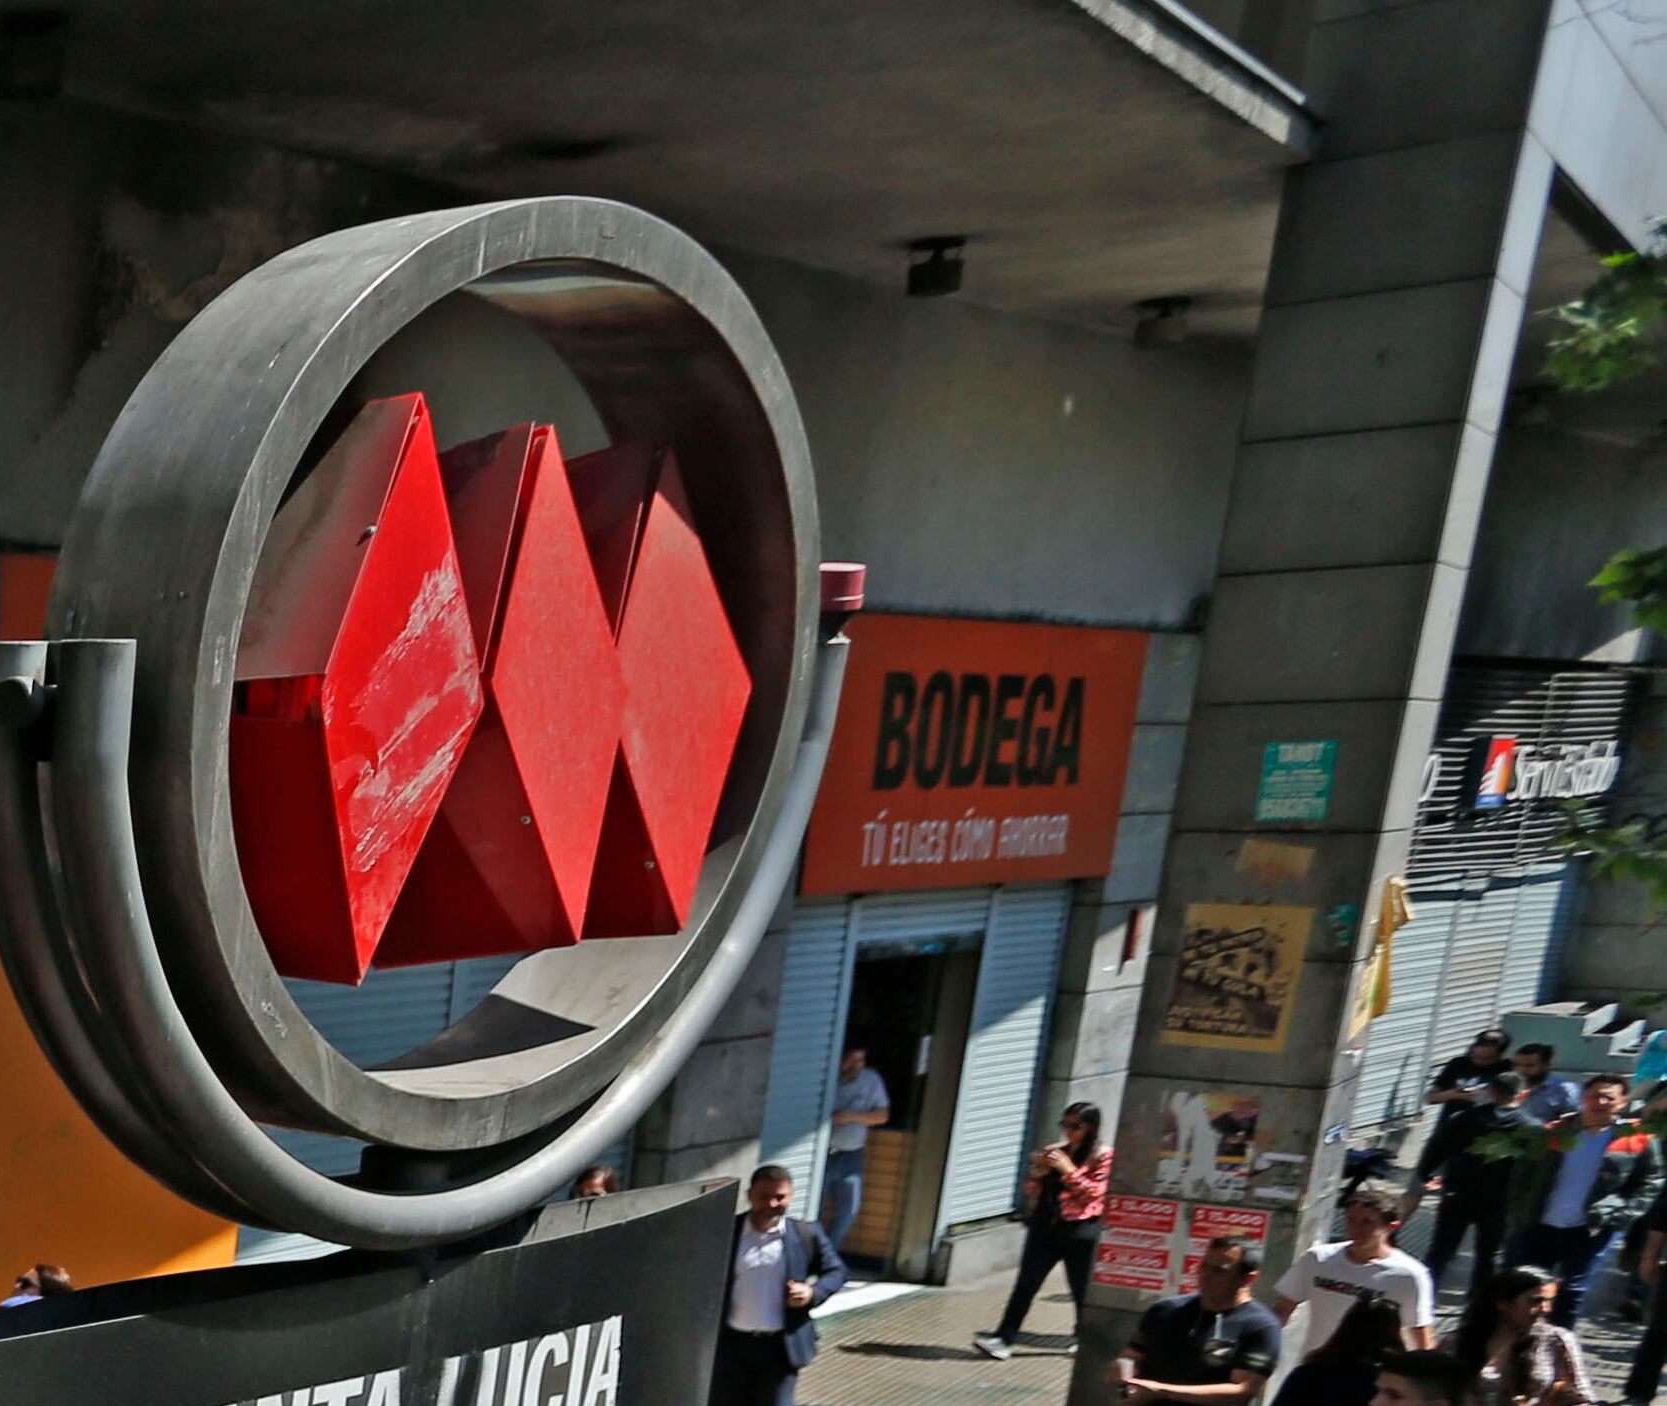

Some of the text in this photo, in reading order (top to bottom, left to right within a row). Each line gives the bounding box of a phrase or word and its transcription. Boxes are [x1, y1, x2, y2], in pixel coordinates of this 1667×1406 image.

[871, 669, 1086, 790] BODEGA
[861, 808, 888, 867] TÚ
[888, 819, 949, 865] ELIGES
[950, 807, 996, 863] CÓMO
